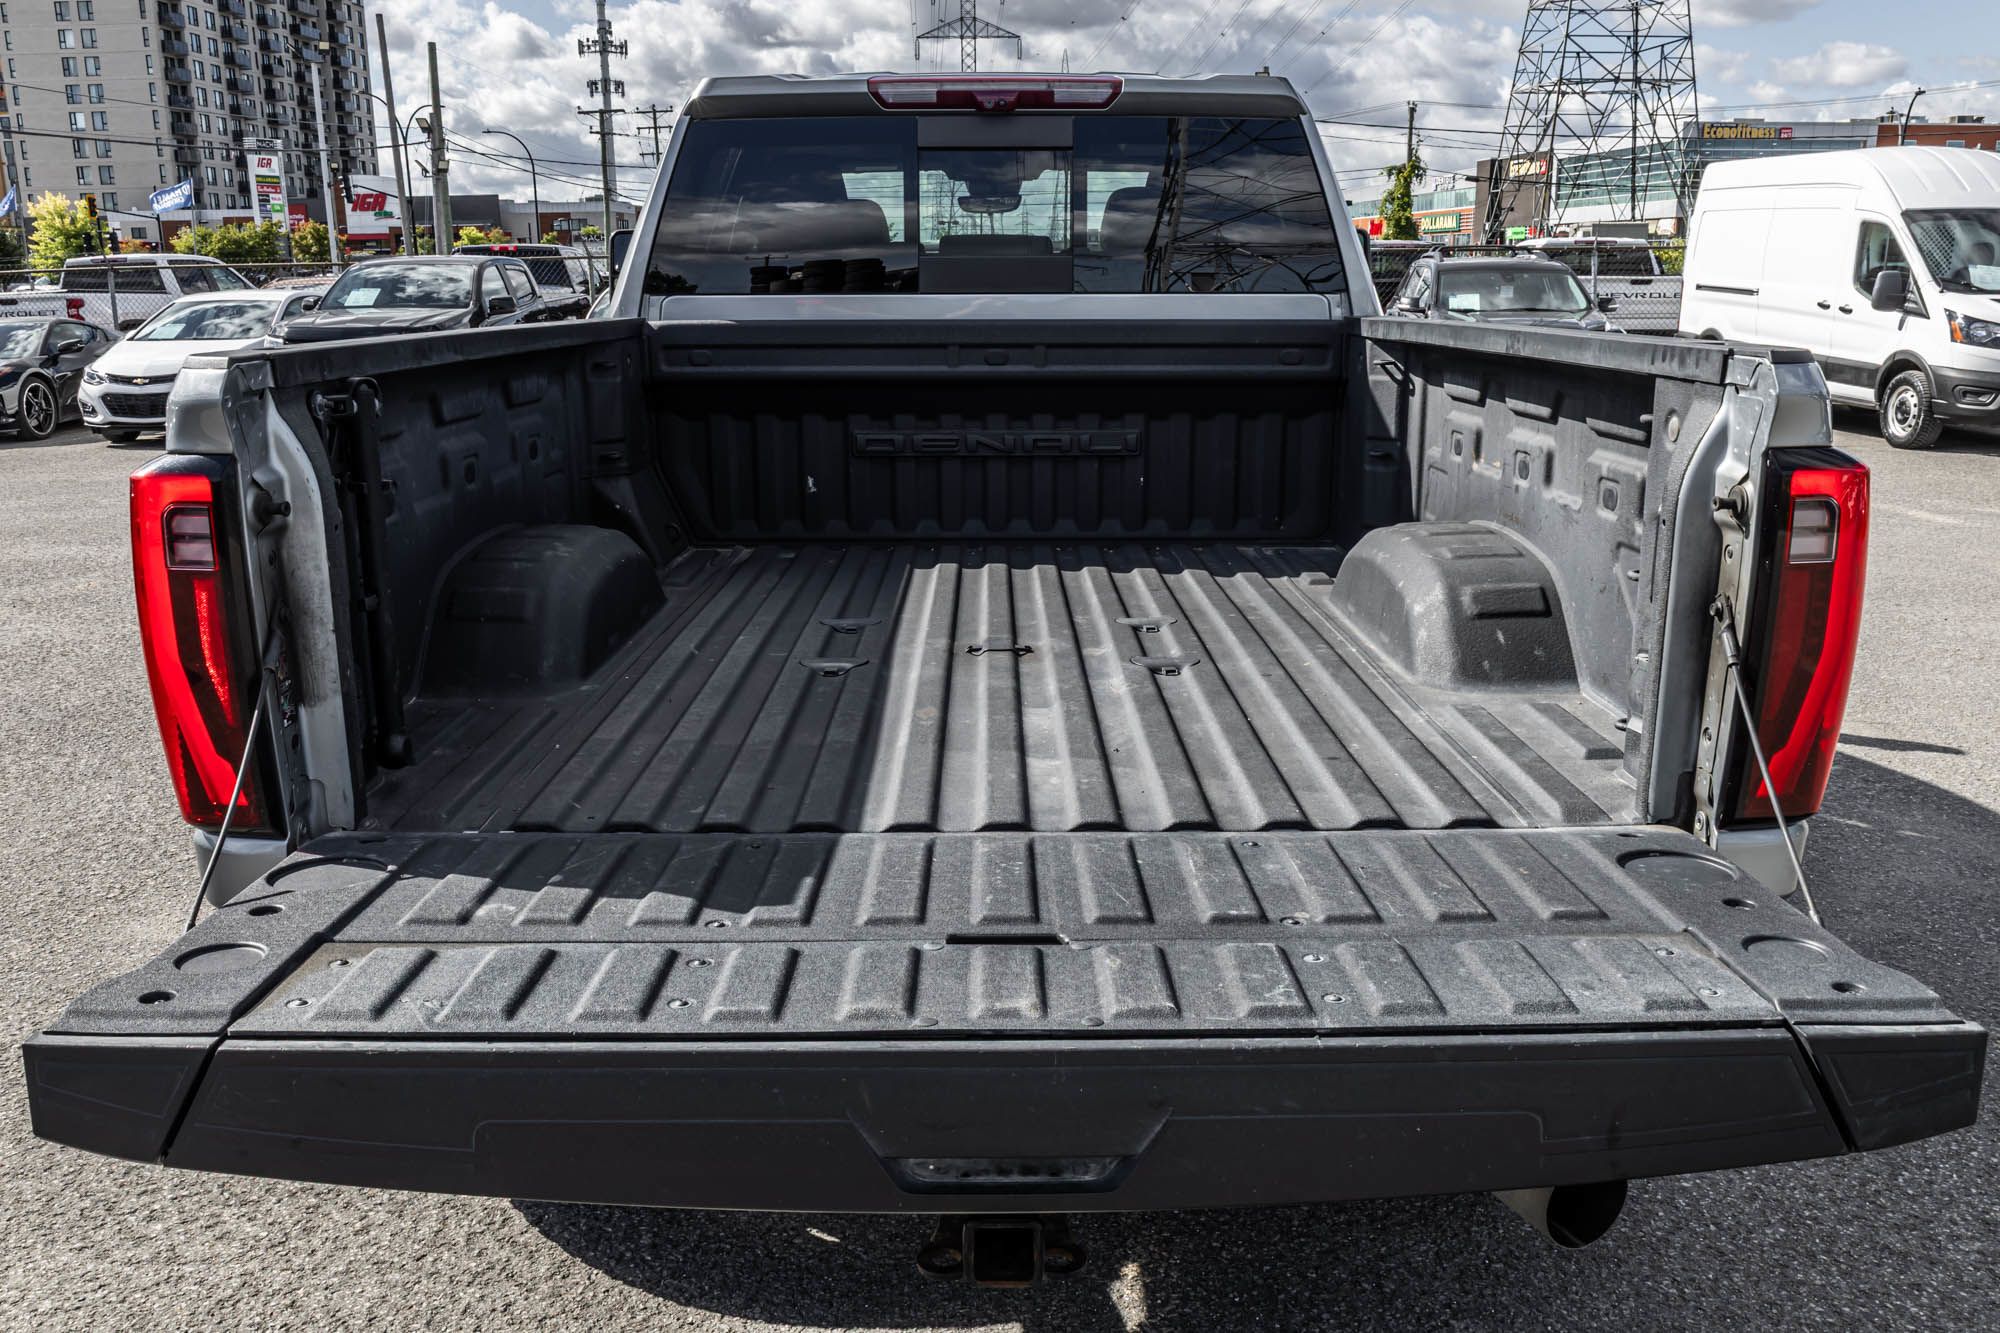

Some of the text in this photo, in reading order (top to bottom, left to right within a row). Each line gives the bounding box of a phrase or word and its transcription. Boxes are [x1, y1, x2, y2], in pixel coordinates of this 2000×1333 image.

[257, 157, 273, 169] IGA
[351, 193, 387, 212] IGA
[1420, 215, 1457, 230] DOLLARAMA
[855, 433, 1140, 454] DENALI
